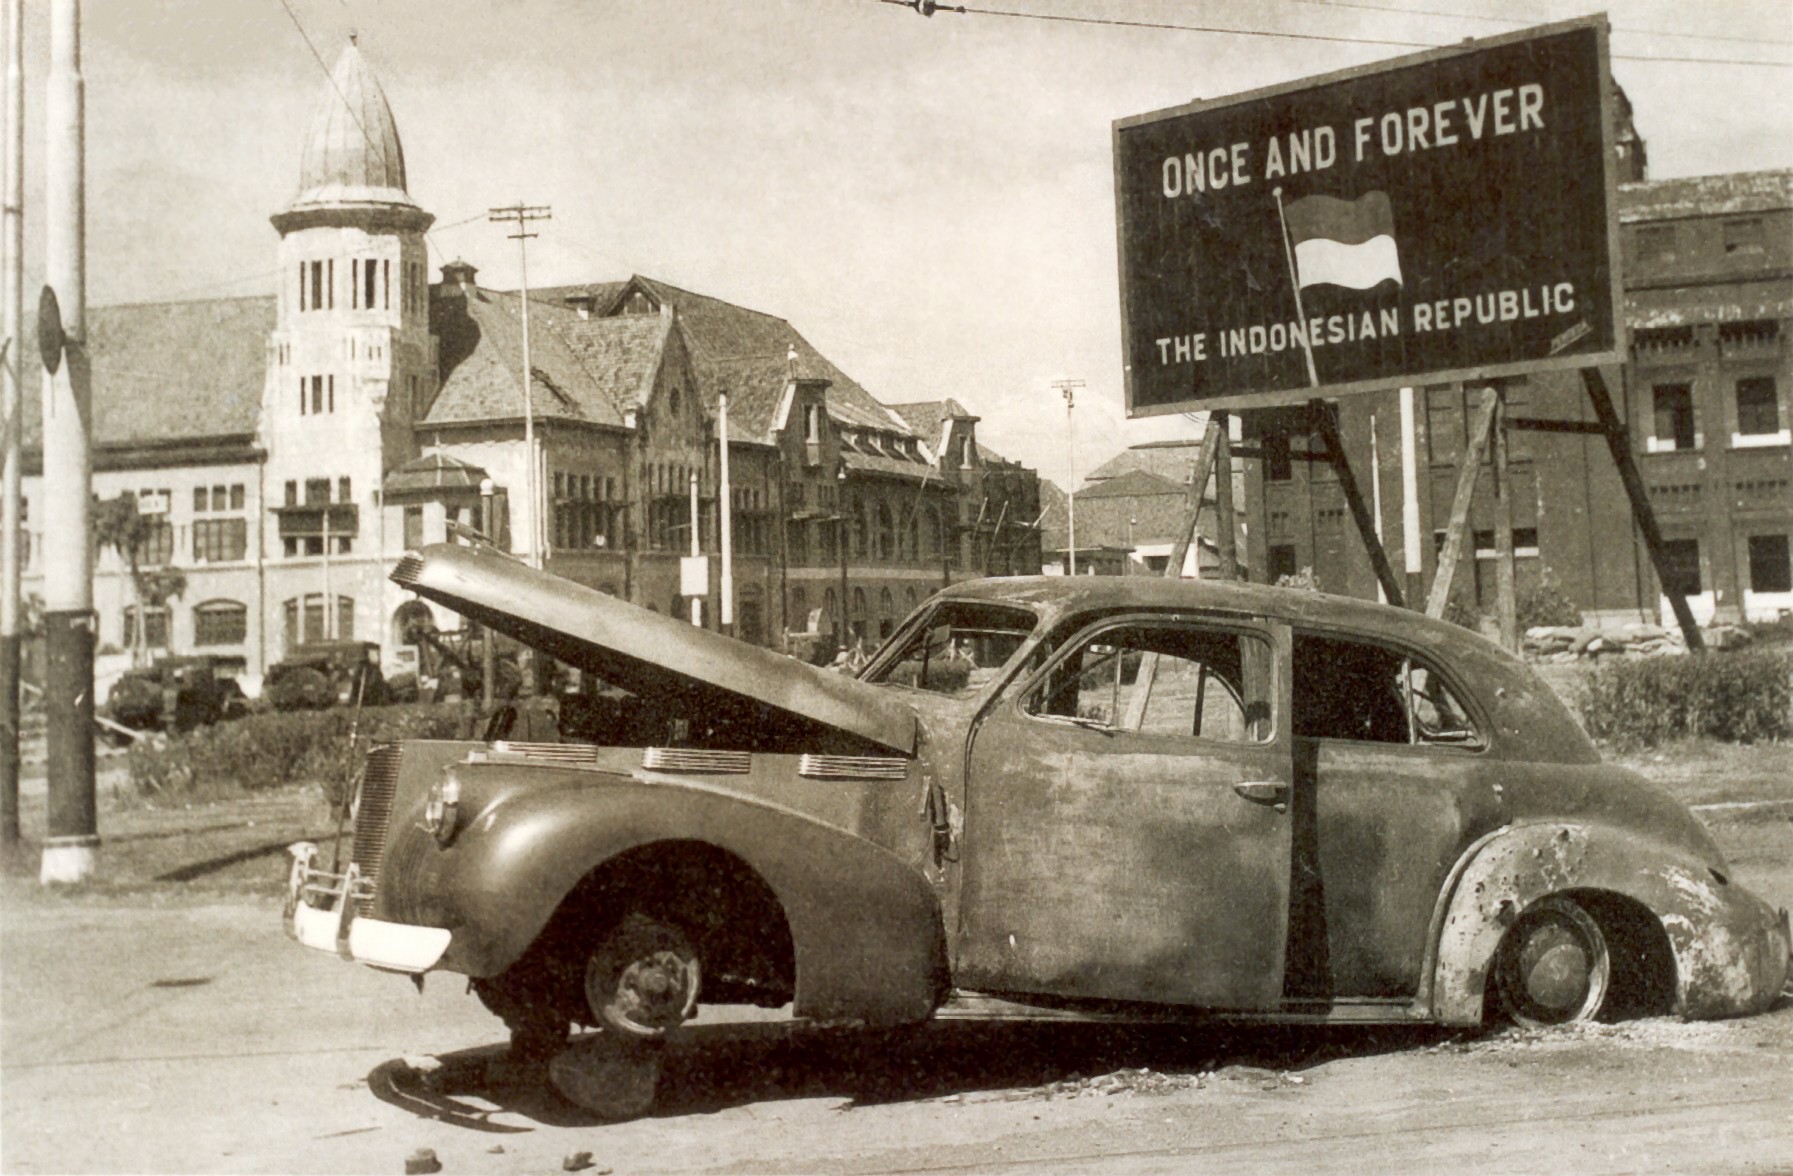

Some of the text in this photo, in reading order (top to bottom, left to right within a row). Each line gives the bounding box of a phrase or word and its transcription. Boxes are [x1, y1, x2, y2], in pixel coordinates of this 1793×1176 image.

[1162, 83, 1545, 198] ONCE AND FOREVER
[1156, 283, 1575, 365] THE INDONESIAN REPUBLIC
